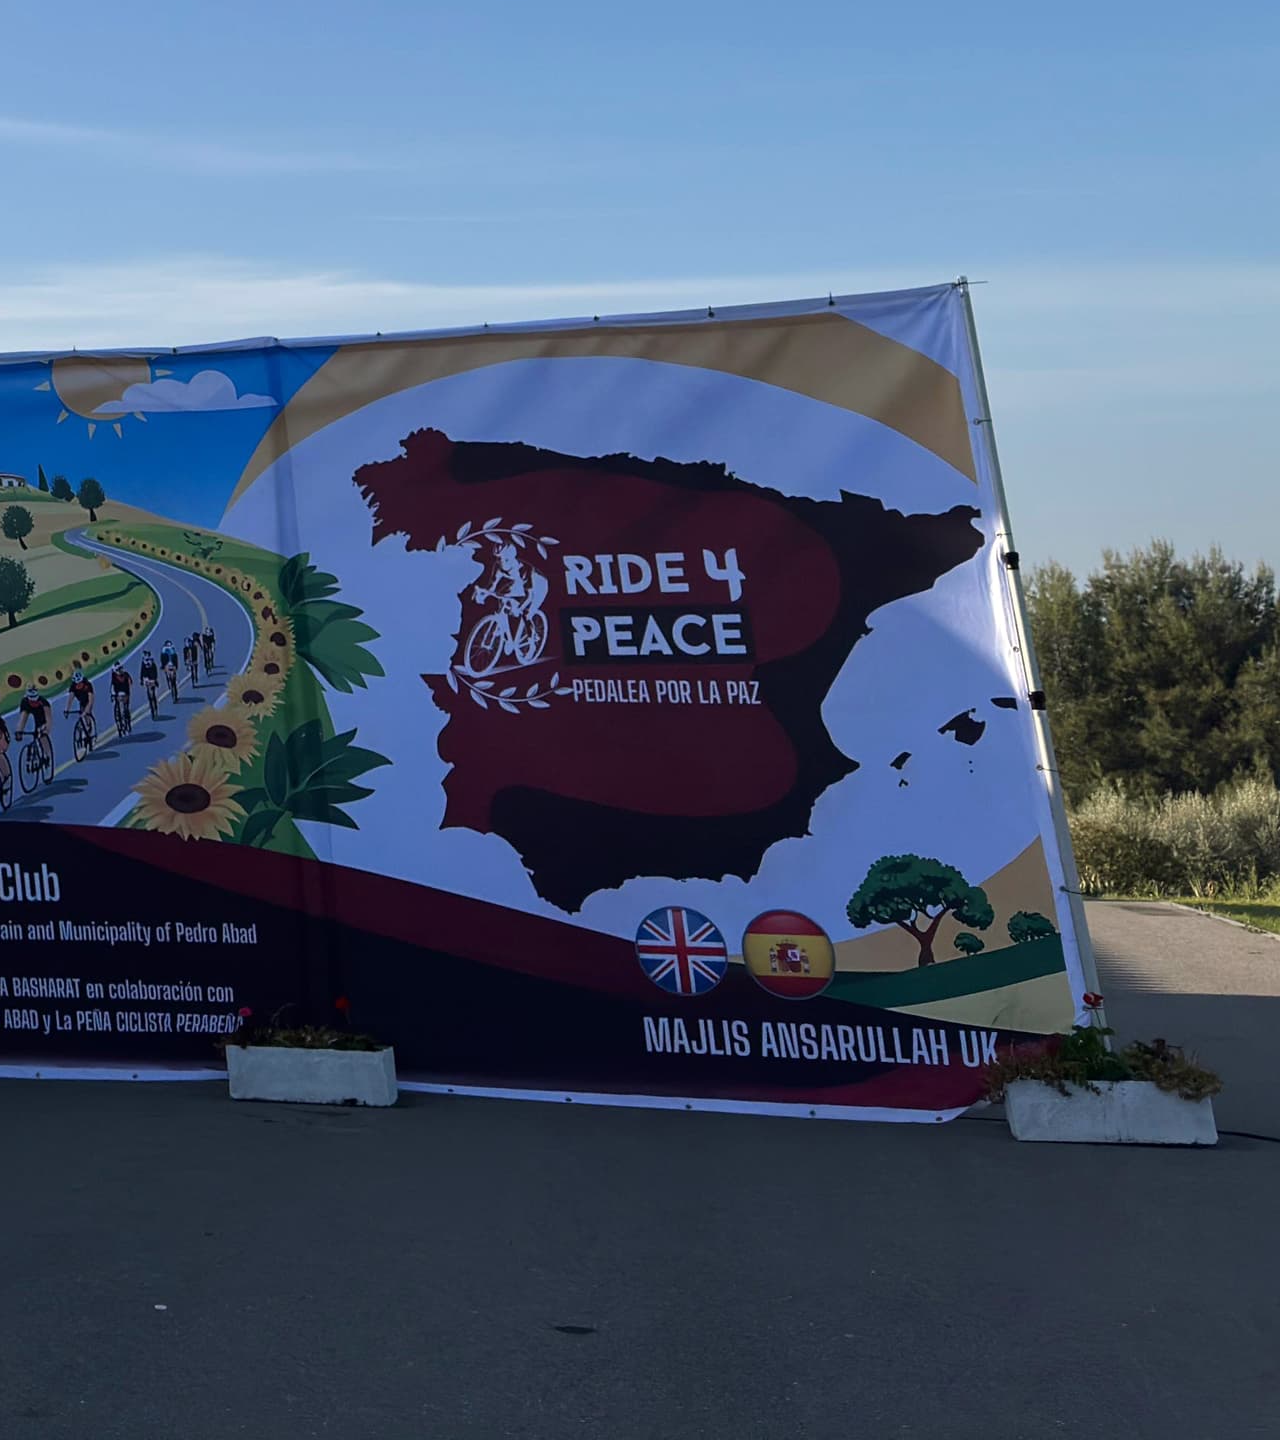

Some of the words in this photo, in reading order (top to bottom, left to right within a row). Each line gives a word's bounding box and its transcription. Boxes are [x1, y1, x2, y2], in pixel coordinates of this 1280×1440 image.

[562, 552, 690, 595] RIDE
[702, 548, 746, 602] 4
[570, 613, 748, 656] PEACE
[572, 679, 651, 703] PEDALEA
[655, 680, 692, 703] POR
[698, 680, 721, 704] LA
[727, 681, 762, 705] PAZ
[28, 920, 55, 941] and
[58, 920, 151, 946] Municipality
[156, 922, 171, 943] of
[175, 922, 218, 943] Pedro
[222, 922, 257, 944] Abad
[12, 977, 80, 999] BASHARAT
[86, 981, 104, 999] en
[108, 979, 203, 1002] colaboración
[207, 985, 234, 1003] con
[3, 1009, 38, 1030] ABAD
[43, 1013, 51, 1034] y
[55, 1010, 72, 1031] La
[76, 1009, 112, 1032] PEÑA
[116, 1011, 173, 1033] CICLISTA
[643, 1015, 751, 1056] MAJLIS
[761, 1021, 950, 1067] ANSARULLAH
[959, 1030, 1000, 1068] UK
